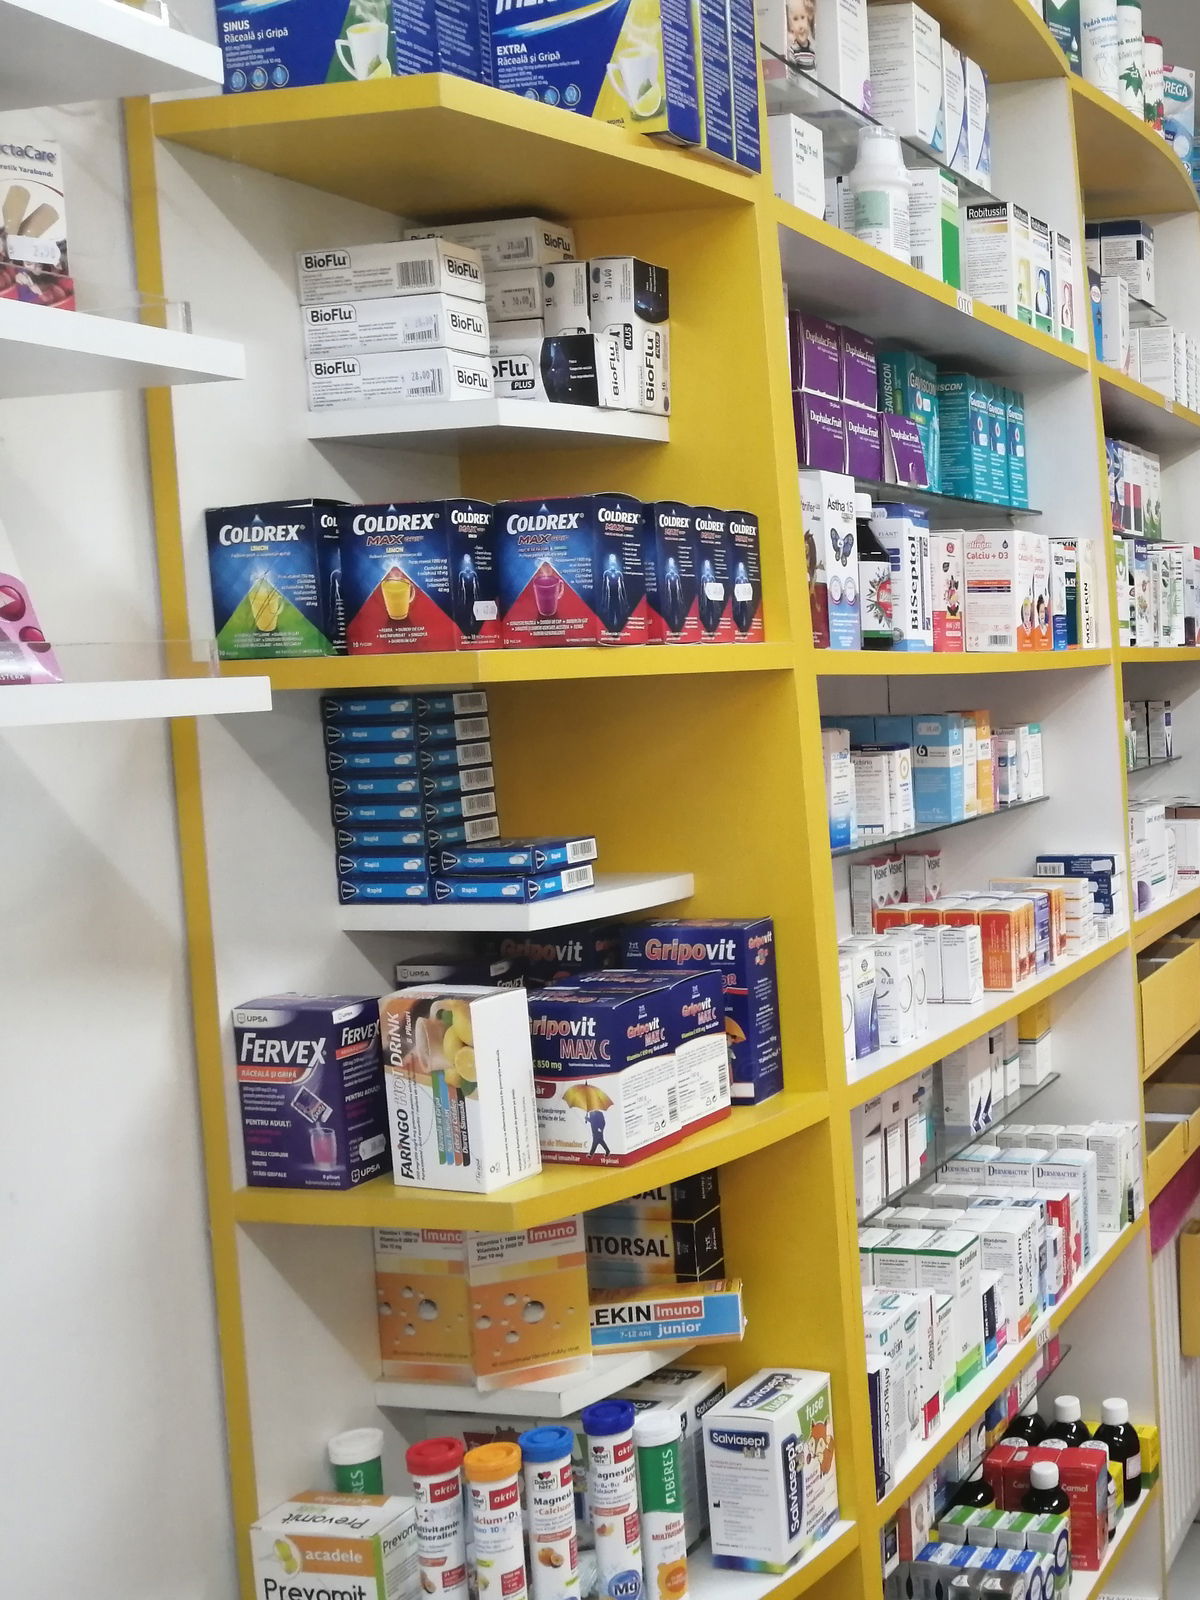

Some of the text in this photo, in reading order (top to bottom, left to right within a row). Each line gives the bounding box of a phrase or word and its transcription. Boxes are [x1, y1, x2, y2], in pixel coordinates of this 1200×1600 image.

[223, 20, 250, 32] SINUS
[224, 30, 256, 43] Răceală
[266, 27, 289, 39] Gripă
[497, 43, 527, 56] EXTRA
[0, 143, 56, 164] ctaCare
[968, 206, 1008, 219] Robitussin
[544, 233, 571, 252] BioFlu
[304, 256, 347, 270] BioFlu
[447, 260, 479, 279] BioFlu
[958, 296, 972, 314] OTC
[310, 310, 352, 323] BioFlu
[451, 314, 482, 334] BioFlu
[624, 326, 632, 347] PLUS
[314, 362, 356, 376] BioFlu
[491, 360, 528, 378] Flu
[646, 338, 655, 402] BioFlu
[457, 370, 488, 388] BioFlu
[514, 380, 533, 390] PLUS
[937, 382, 963, 392] ISCON
[353, 514, 434, 535] COLDREX
[451, 510, 489, 525] COLDREX
[506, 513, 579, 534] COLDREX
[598, 508, 639, 525] COLDREX
[659, 514, 690, 528] COLDREX
[695, 518, 724, 532] COLDREX
[219, 524, 300, 546] COLDREX
[729, 521, 757, 535] COLDREX
[366, 534, 404, 546] MAX
[518, 534, 551, 545] MAX
[966, 552, 990, 560] Calciu
[908, 536, 919, 630] Biseptol
[748, 931, 772, 949] Gripovit
[645, 938, 736, 965] Gripovit
[682, 997, 712, 1017] Gripovit
[698, 1009, 712, 1025] MAX
[342, 1019, 379, 1046] FERVEX
[530, 1016, 596, 1040] ripovit
[627, 1017, 660, 1039] Gripovit
[386, 1012, 404, 1068] DRINK
[645, 1028, 660, 1047] MAX
[241, 1032, 326, 1067] FERVEX
[560, 1039, 611, 1060] MAX C
[537, 1060, 562, 1071] 850 mg
[246, 1119, 268, 1127] PENTRU
[396, 1109, 415, 1180] FARINGO
[361, 1164, 381, 1177] UPSA
[941, 1165, 981, 1174] DERMOBACTER
[988, 1166, 1028, 1176] DERMOBACTER
[1037, 1167, 1077, 1178] DERMOBACTER
[530, 1225, 575, 1241] Imuno
[587, 1236, 670, 1258] ITORSAL
[590, 1305, 651, 1326] EKIN
[656, 1304, 700, 1317] Imuno
[657, 1322, 701, 1338] junior
[696, 1389, 725, 1417] Salviasept
[712, 1432, 766, 1447] Salviasept
[662, 1449, 677, 1496] BÉRES
[351, 1470, 364, 1494] RES
[434, 1483, 457, 1496] aktiv
[786, 1441, 800, 1533] Salviasept
[1013, 1481, 1030, 1490] Car
[1062, 1483, 1088, 1492] Carmol
[494, 1490, 516, 1503] aktiv
[281, 1513, 370, 1530] Prevomit
[382, 1523, 418, 1554] Prevom
[305, 1549, 363, 1564] acadele
[264, 1578, 366, 1600] Prevomit
[614, 1583, 638, 1597] Mg
